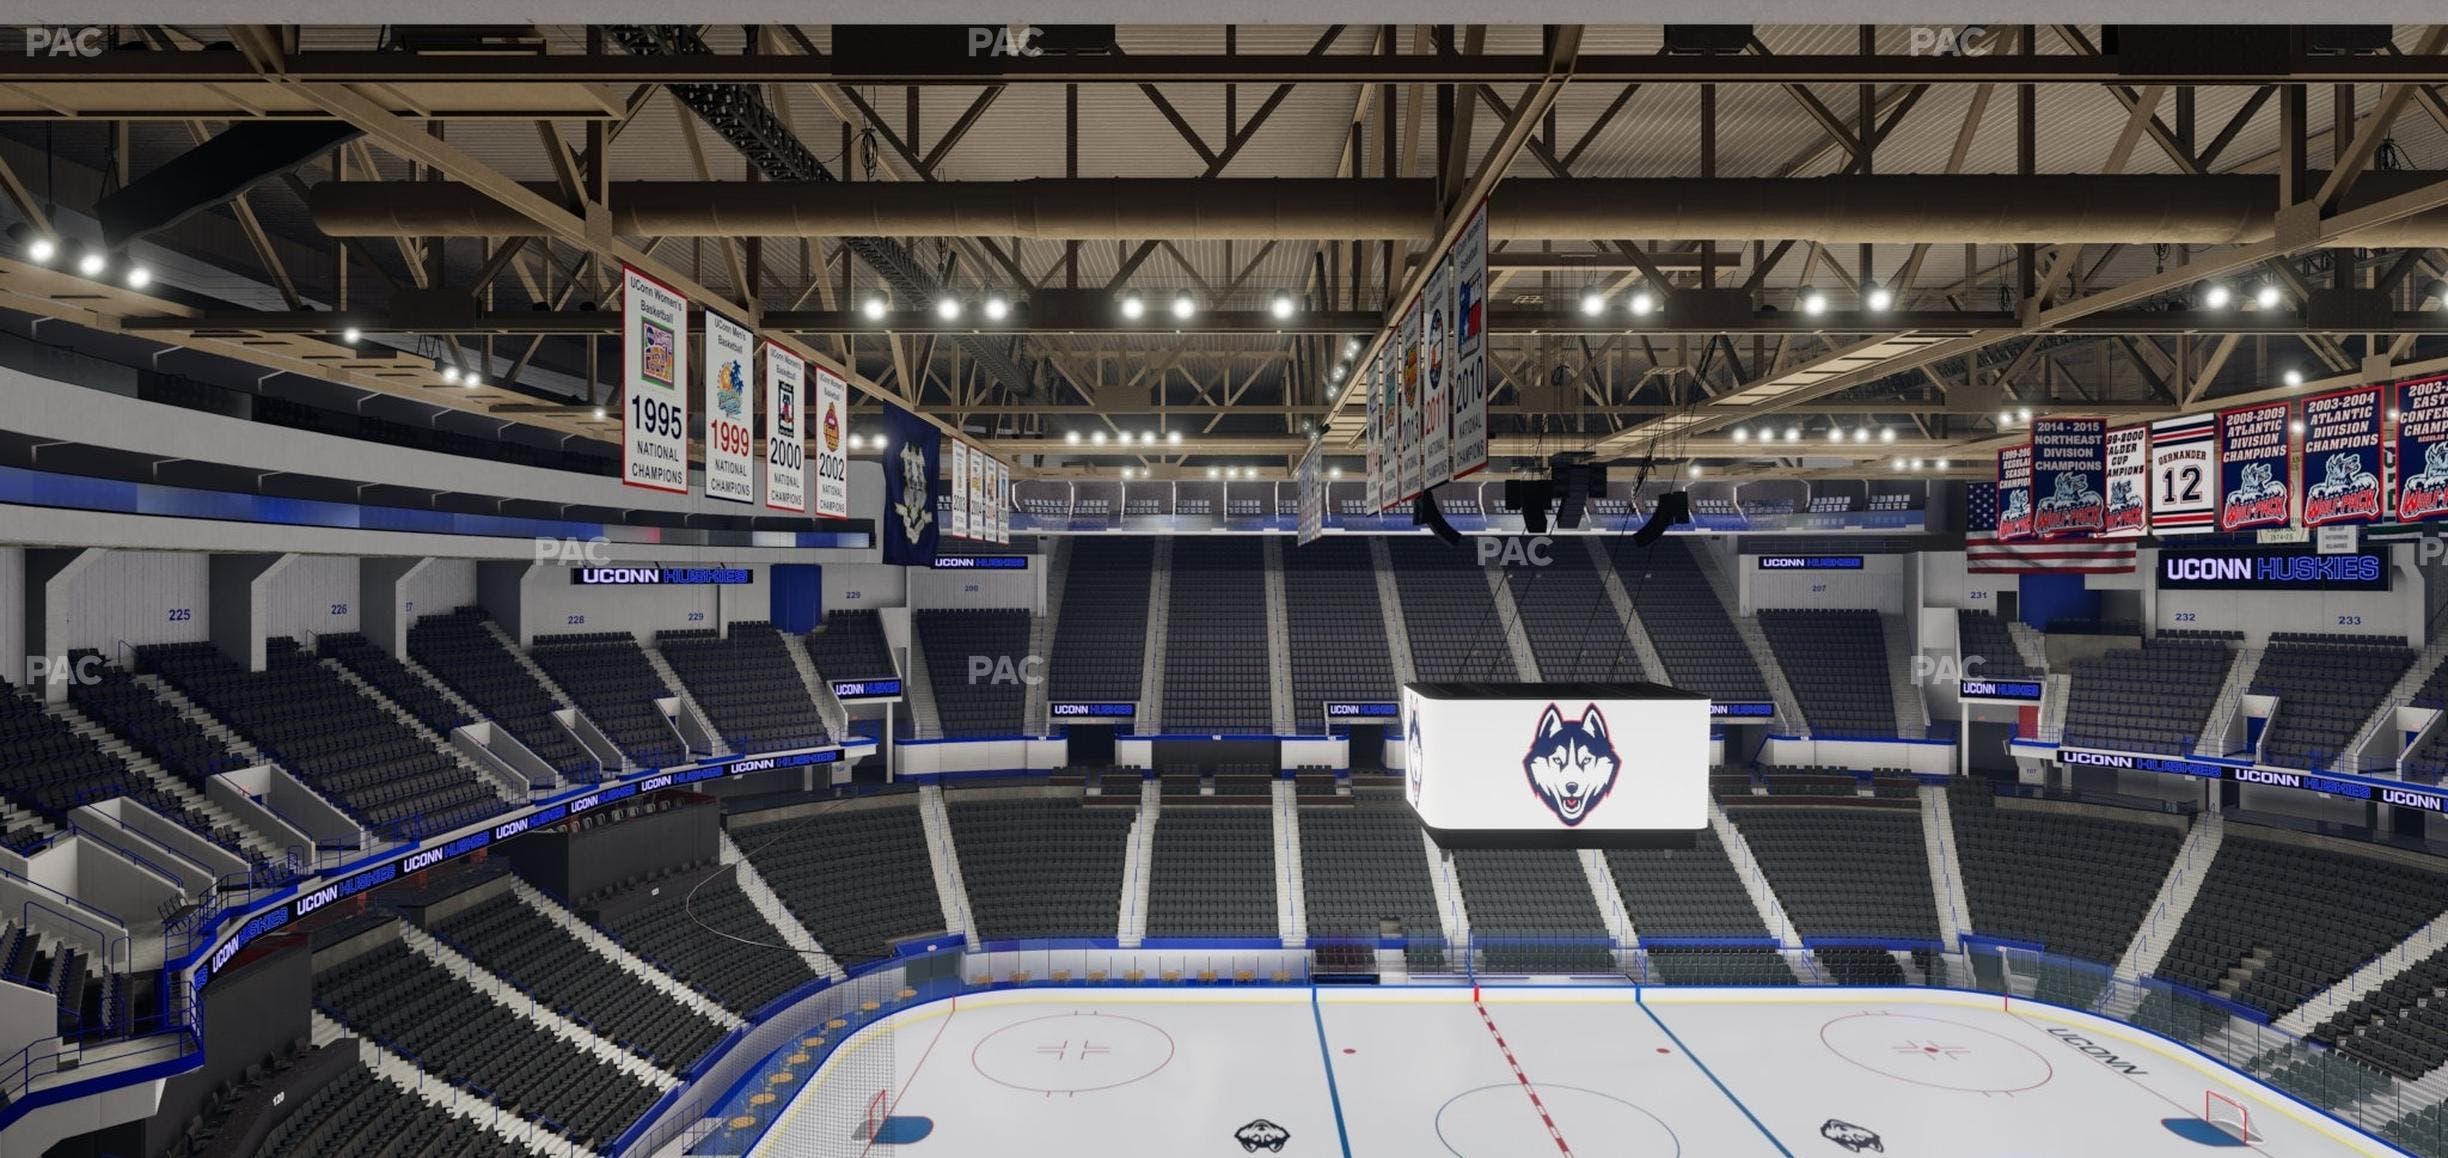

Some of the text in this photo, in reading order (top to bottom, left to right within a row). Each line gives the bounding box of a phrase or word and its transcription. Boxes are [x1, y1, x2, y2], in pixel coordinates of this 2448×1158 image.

[630, 276, 682, 312] UConn Women's
[640, 299, 674, 324] Basketball
[714, 318, 746, 341] UConn Men's
[718, 334, 743, 354] Basketball
[1456, 355, 1484, 414] 2010
[2408, 381, 2448, 397] 2003-
[1425, 389, 1446, 435] 2011
[2308, 391, 2376, 413] 2003-2004
[2413, 395, 2448, 410] EAST
[632, 394, 683, 440] 1995
[2226, 406, 2286, 426] 2008-2009
[2310, 406, 2373, 426] ATLANTIC
[2038, 422, 2064, 432] 2014
[2073, 422, 2099, 432] 2015
[2227, 420, 2282, 437] ATLANTIC
[2313, 421, 2369, 439] DIVISION
[711, 418, 750, 457] 1999
[2034, 435, 2102, 445] NORTHEAST
[2230, 433, 2279, 449] DIVISION
[2305, 434, 2379, 454] CHAMPIONS
[637, 441, 679, 463] NATIONAL
[770, 437, 802, 471] 2000
[2043, 448, 2093, 458] DIVISION
[2107, 443, 2137, 456] ALDER
[2158, 450, 2207, 466] GERNANDER
[2223, 445, 2287, 463] CHAMPIONS
[715, 459, 747, 477] NATIONAL
[819, 452, 845, 482] 2002
[2035, 461, 2102, 471] CHAMPIONS
[2111, 456, 2128, 466] CUP
[631, 462, 683, 485] CHAMPIONS
[711, 477, 751, 497] CHAMPIONS
[2162, 463, 2203, 506] 12
[935, 558, 974, 567] UCONN
[1763, 559, 1804, 567] UCONN
[2168, 556, 2379, 581] UCONN HUSKIES
[583, 568, 747, 584] UCONN HUSKIES
[169, 609, 191, 621] 225
[331, 604, 347, 615] 226
[688, 613, 704, 621] 229
[2175, 613, 2196, 621] 232
[2338, 616, 2361, 625] 233
[836, 682, 864, 695] UCONN
[1963, 683, 2039, 697] UCONN HUSKIES
[1054, 704, 1133, 715] UCONN HUSKIES
[1330, 705, 1359, 714] UCONN
[1709, 704, 1728, 714] ONN
[731, 759, 775, 774] UCONN
[776, 750, 837, 768] HUSKIES
[2064, 752, 2221, 777] UCONN HUSKIES
[641, 766, 724, 792] UCONN HUSKIES
[2235, 769, 2371, 799] UCONN HUSKIES
[571, 795, 599, 813] UCONN
[2383, 789, 2440, 811] UCONN
[496, 818, 529, 840] UCONN
[404, 847, 443, 873] UCONN
[297, 863, 396, 916] UCONN HUSKIES
[212, 906, 289, 974] UCONN HUSKIES
[2046, 1028, 2149, 1075] UCONN
